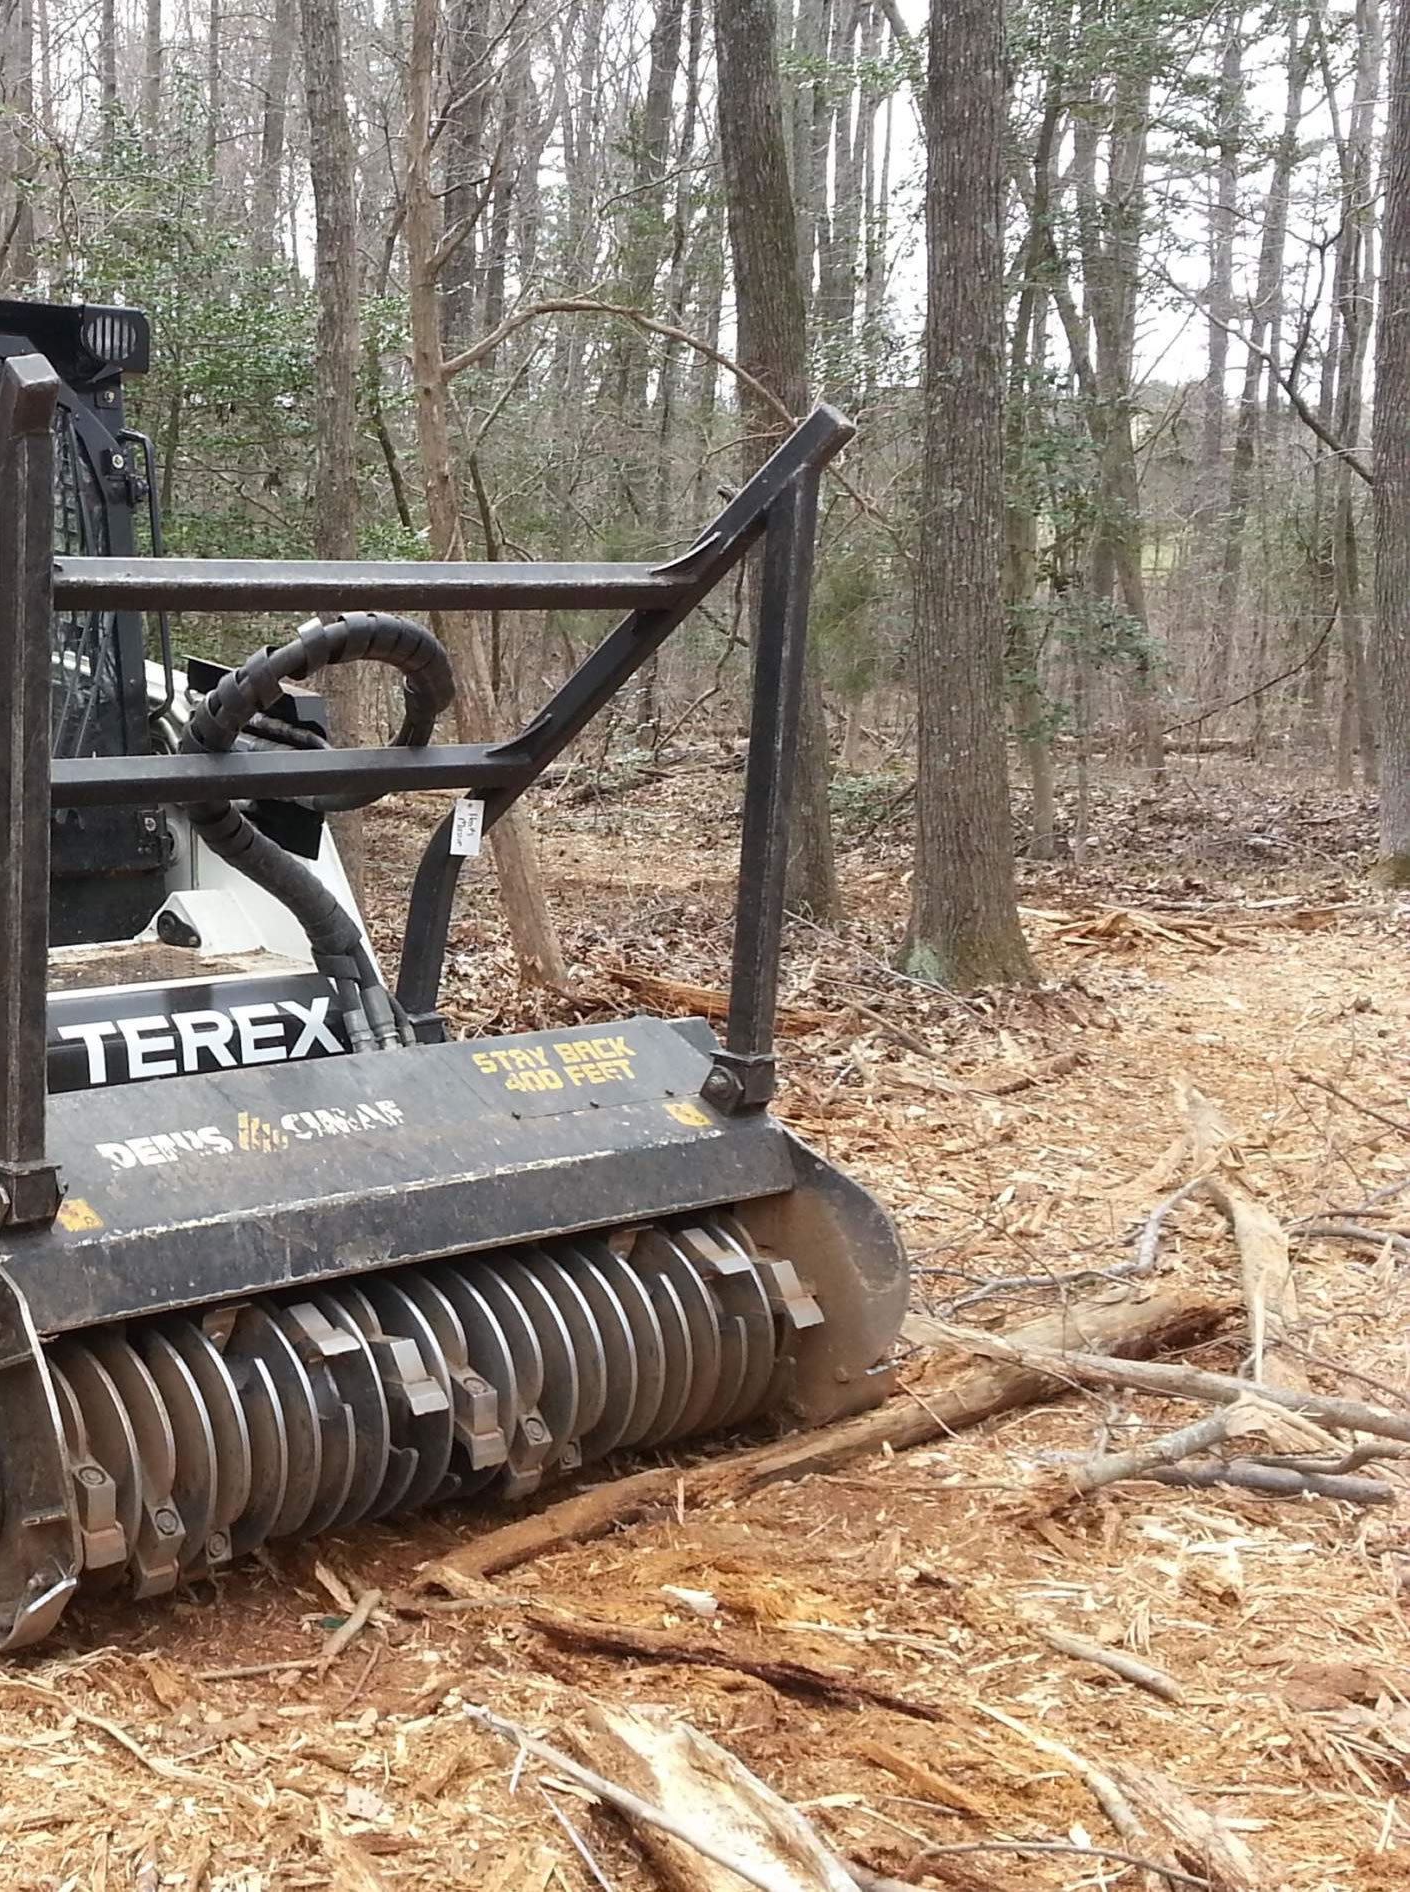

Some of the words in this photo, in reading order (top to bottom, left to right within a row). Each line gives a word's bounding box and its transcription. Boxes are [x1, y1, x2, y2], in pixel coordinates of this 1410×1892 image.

[58, 997, 344, 1084] TEREX
[472, 1046, 549, 1073] STAY
[553, 1036, 637, 1063] BACK
[505, 1068, 564, 1092] 400
[564, 1059, 636, 1087] FEET
